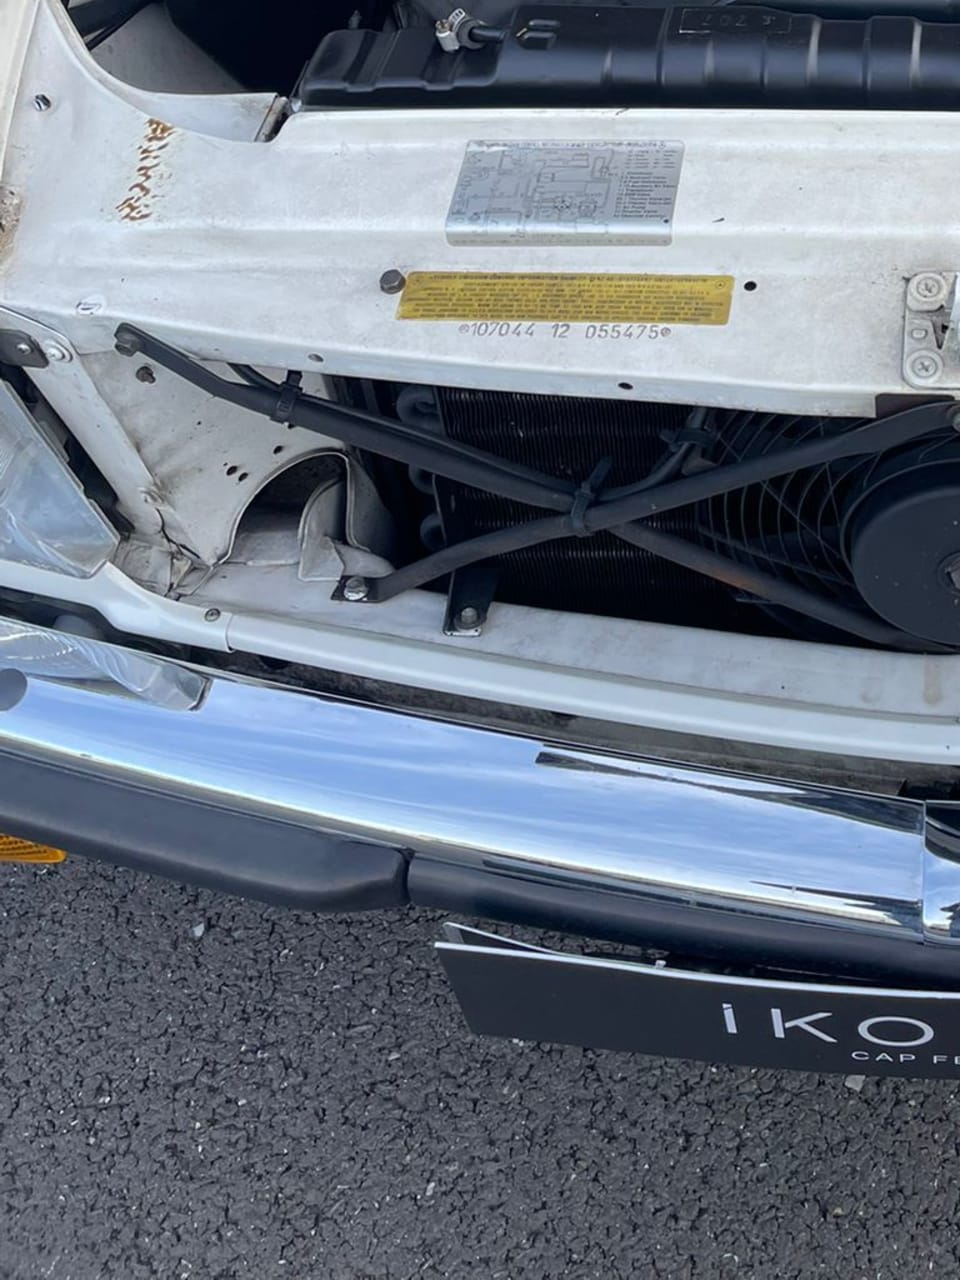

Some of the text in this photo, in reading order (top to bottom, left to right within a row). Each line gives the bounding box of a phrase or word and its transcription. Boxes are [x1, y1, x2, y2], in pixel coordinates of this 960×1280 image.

[471, 322, 659, 339] 107044 12 055475
[851, 1051, 916, 1063] CAP
